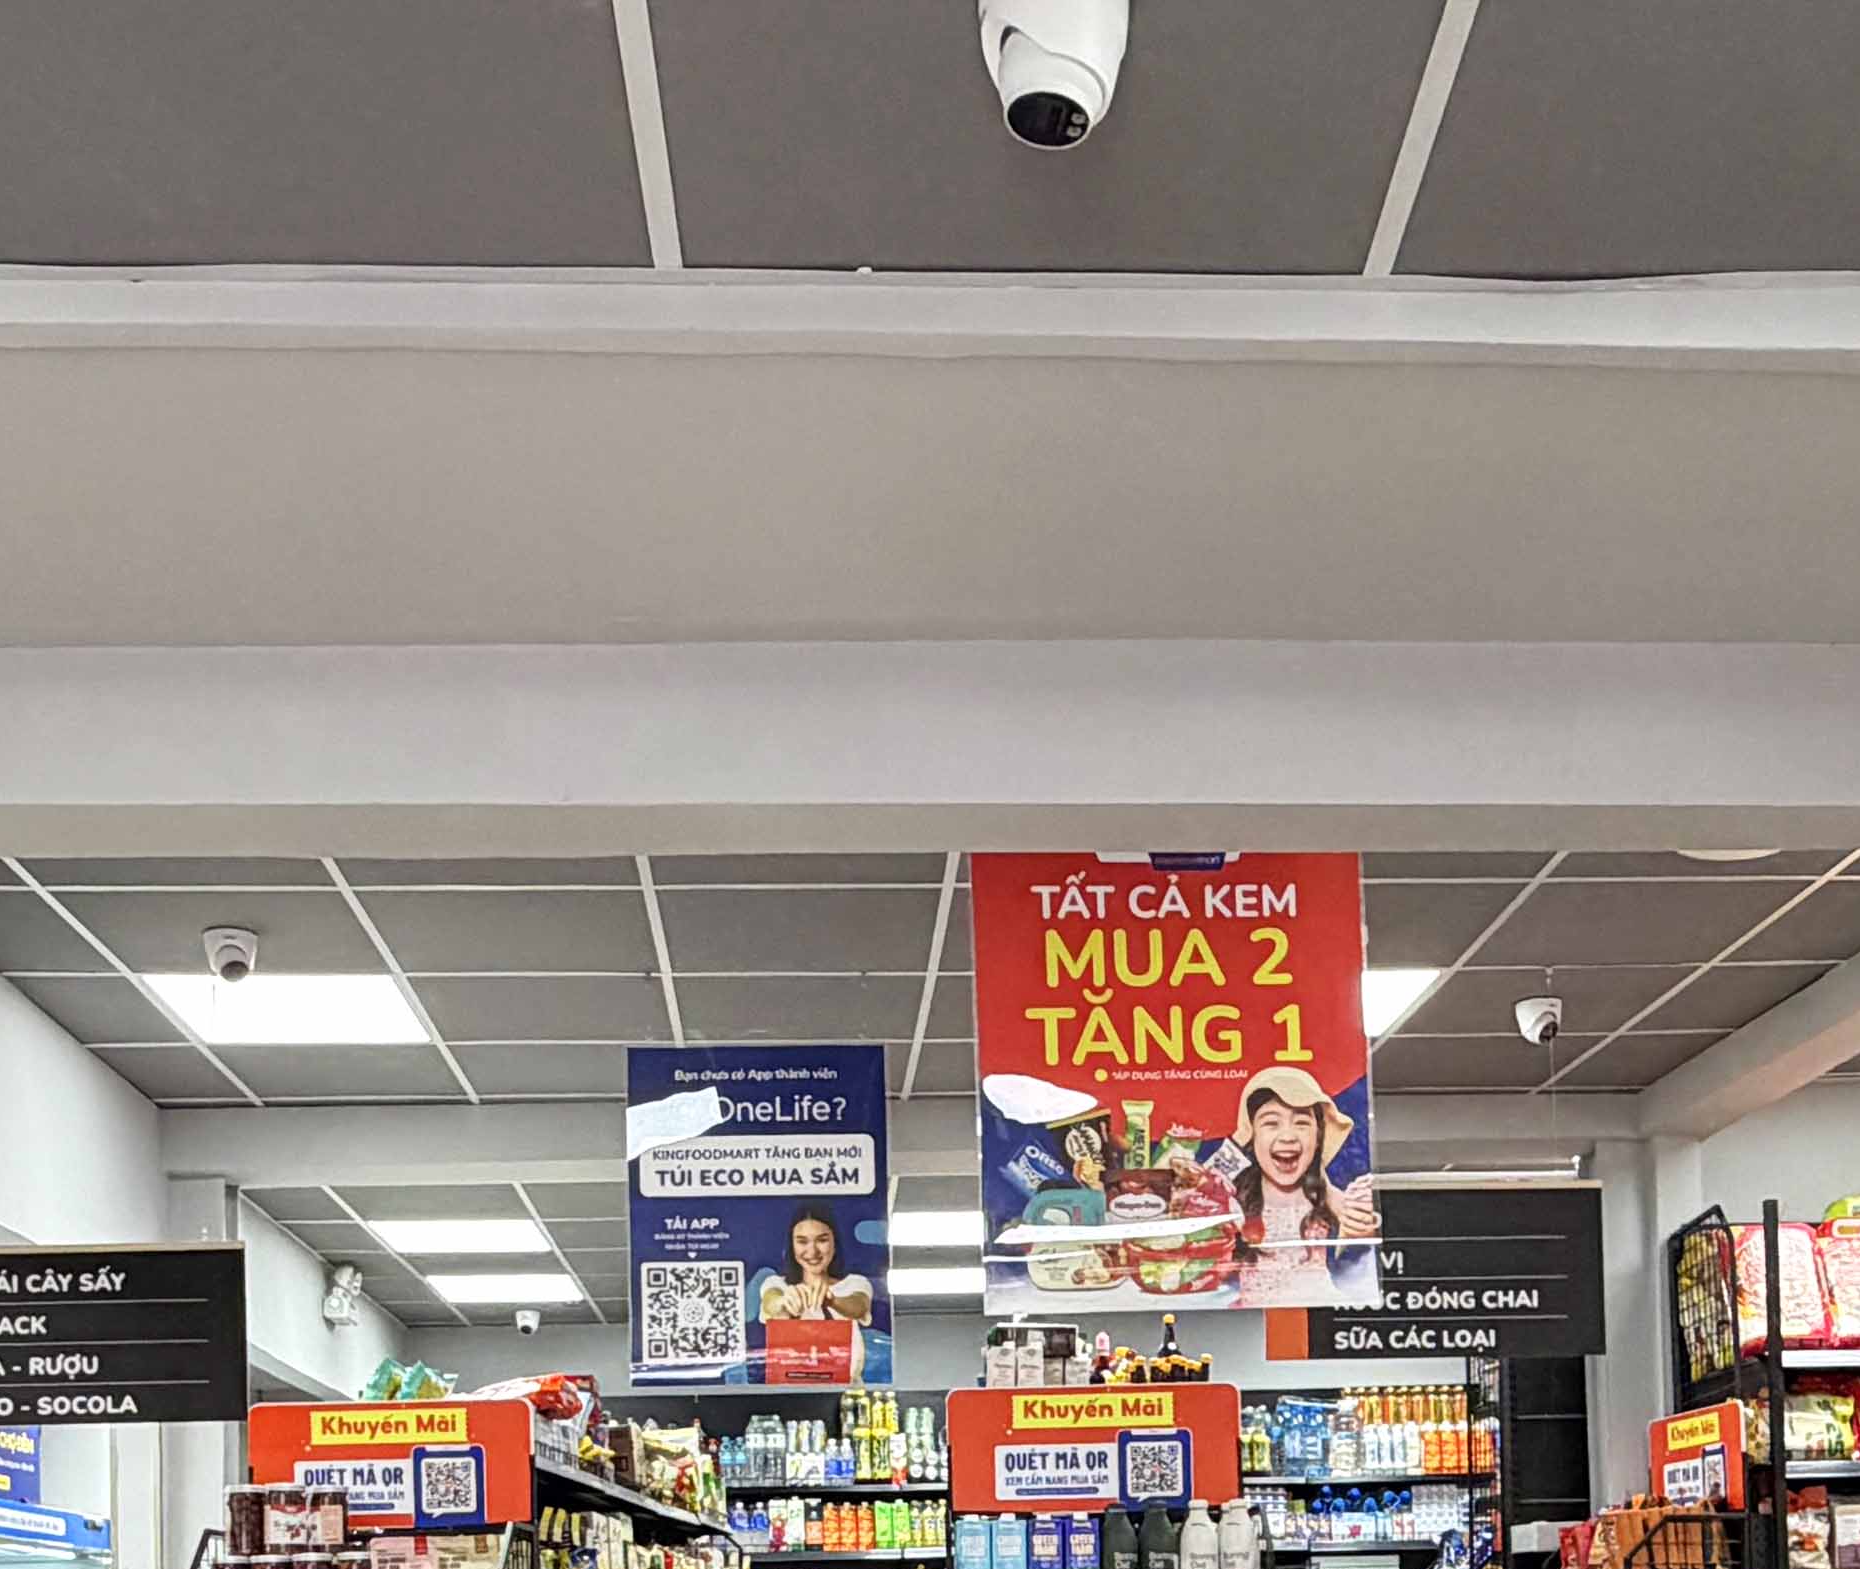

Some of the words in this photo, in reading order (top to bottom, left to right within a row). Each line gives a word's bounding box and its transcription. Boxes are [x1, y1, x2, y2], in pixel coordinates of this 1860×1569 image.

[1030, 871, 1115, 919] TẤT
[1128, 874, 1190, 918] CẢ
[1204, 883, 1296, 917] KEM
[1046, 929, 1226, 987] MUA
[1250, 928, 1293, 985] 2
[1273, 1004, 1313, 1061] 1
[719, 1096, 847, 1123] OneLife?
[652, 1149, 760, 1161] KINGFOODMART
[656, 1165, 691, 1186] TÚI
[699, 1170, 745, 1185] ECO
[752, 1169, 803, 1185] MUA
[691, 1218, 719, 1229] APP
[25, 1268, 73, 1292] CÂY
[79, 1265, 126, 1291] SẤY
[1406, 1288, 1476, 1311] ĐÓNG
[1481, 1289, 1539, 1309] CHAI
[1334, 1326, 1383, 1350] SỮA
[1388, 1326, 1436, 1349] CÁC
[1442, 1329, 1496, 1352] LOẠI
[29, 1353, 99, 1380] RƯỢU
[37, 1395, 138, 1415] SOCOLA
[1005, 1451, 1047, 1471] QUÉT
